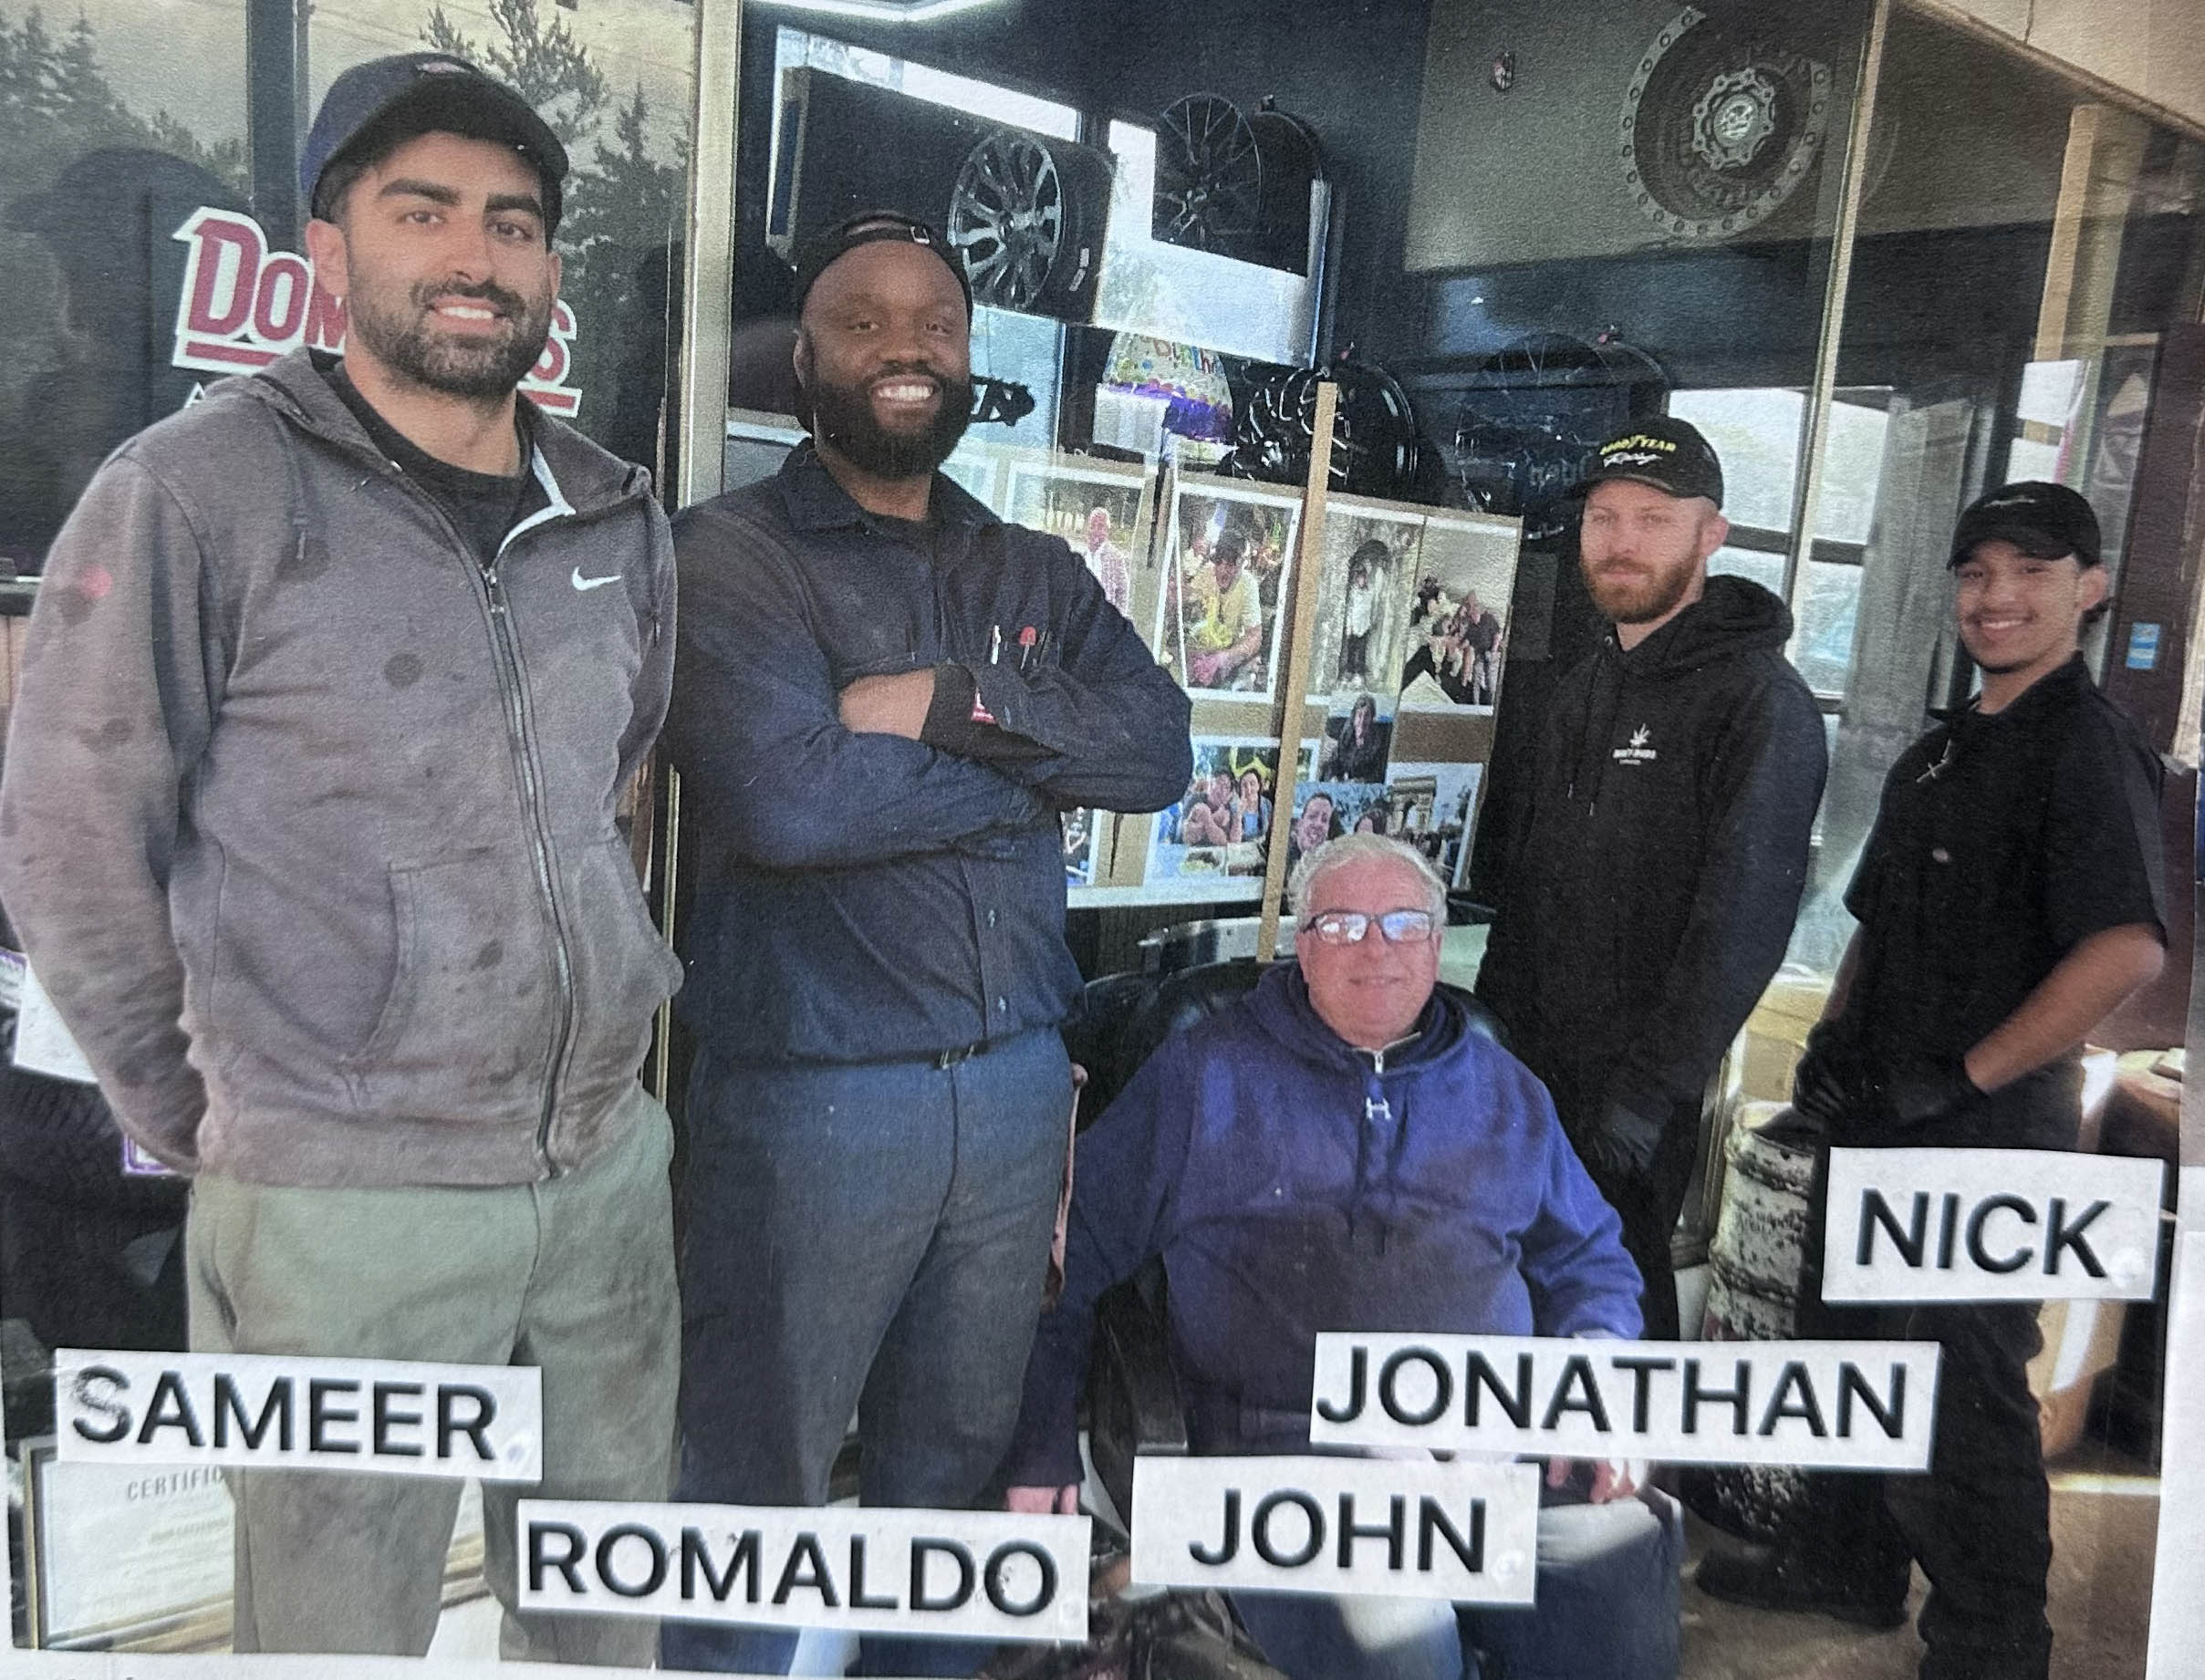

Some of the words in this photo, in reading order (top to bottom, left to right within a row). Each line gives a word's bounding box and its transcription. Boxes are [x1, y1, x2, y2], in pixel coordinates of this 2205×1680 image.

[1856, 1189, 2111, 1280] NICK
[72, 1364, 496, 1462] SAMEER
[1316, 1346, 1908, 1440] JONATHAN
[527, 1520, 1058, 1618] ROMALDO
[1189, 1488, 1487, 1574] JOHN
